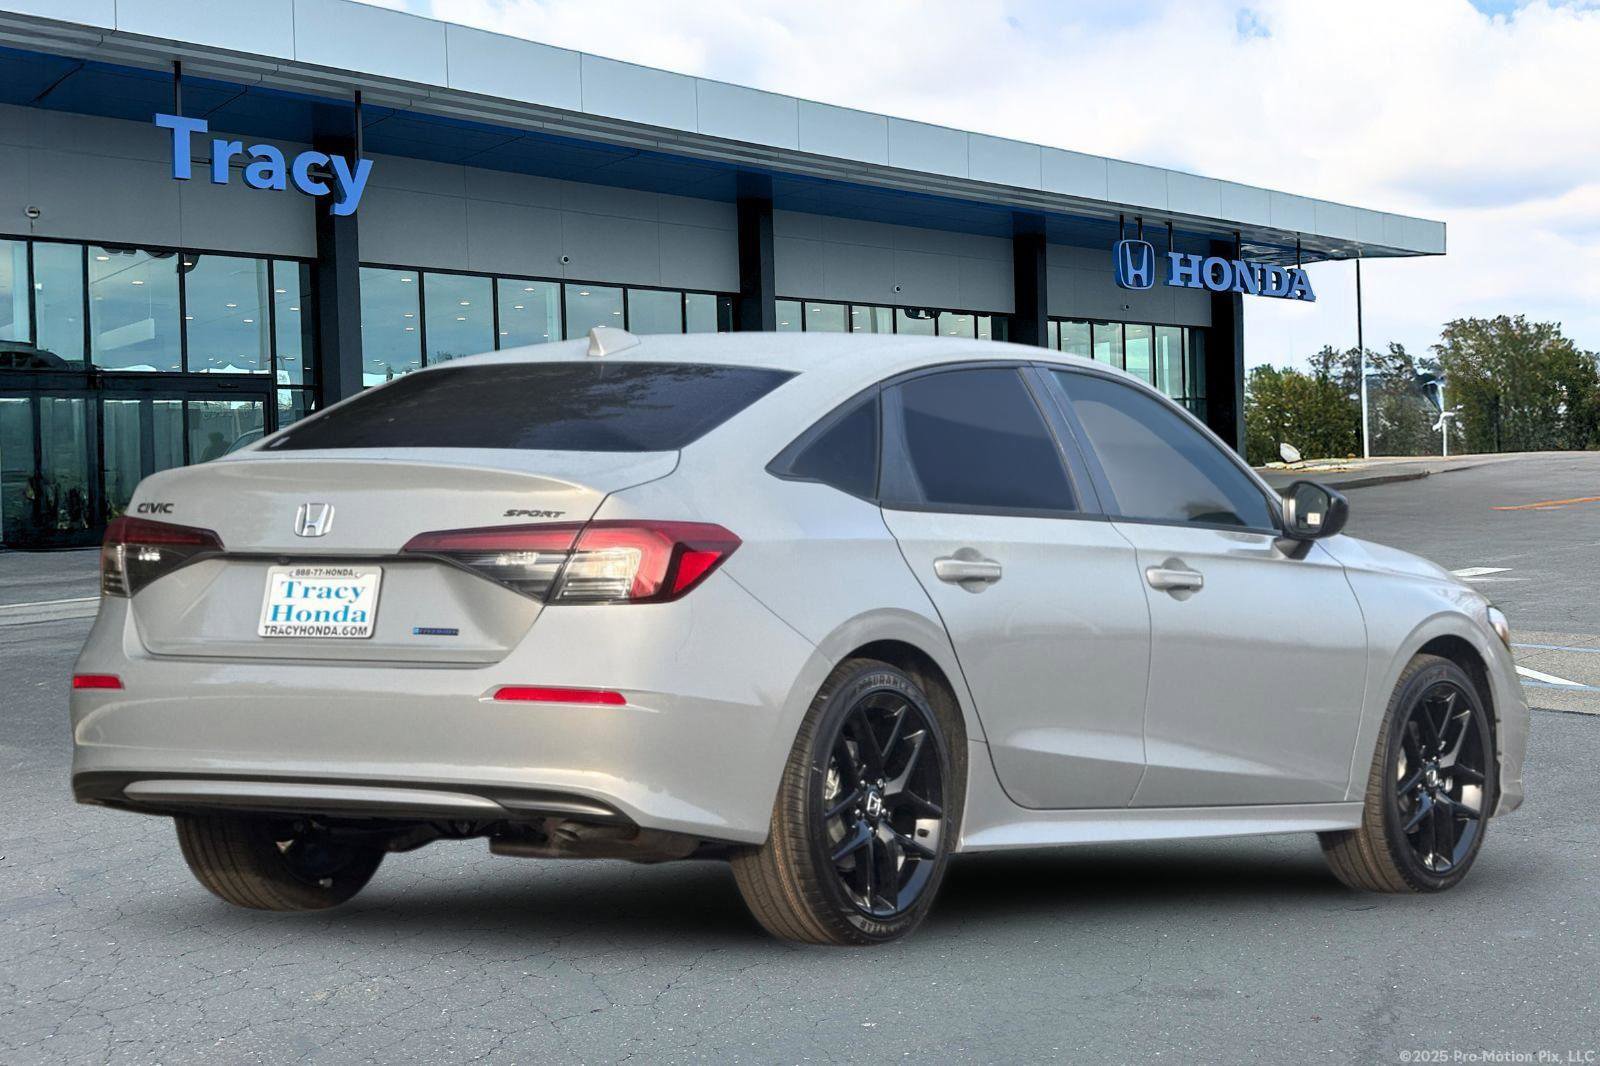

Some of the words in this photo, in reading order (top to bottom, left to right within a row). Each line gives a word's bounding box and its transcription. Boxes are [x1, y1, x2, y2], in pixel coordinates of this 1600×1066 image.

[154, 113, 374, 216] Tracy
[1166, 251, 1316, 302] HONDA
[137, 502, 174, 514] CIVIC
[503, 509, 566, 518] SPORT
[295, 568, 354, 577] 888-77-HONDA
[281, 581, 365, 604] Tracy
[270, 604, 367, 623] Honda
